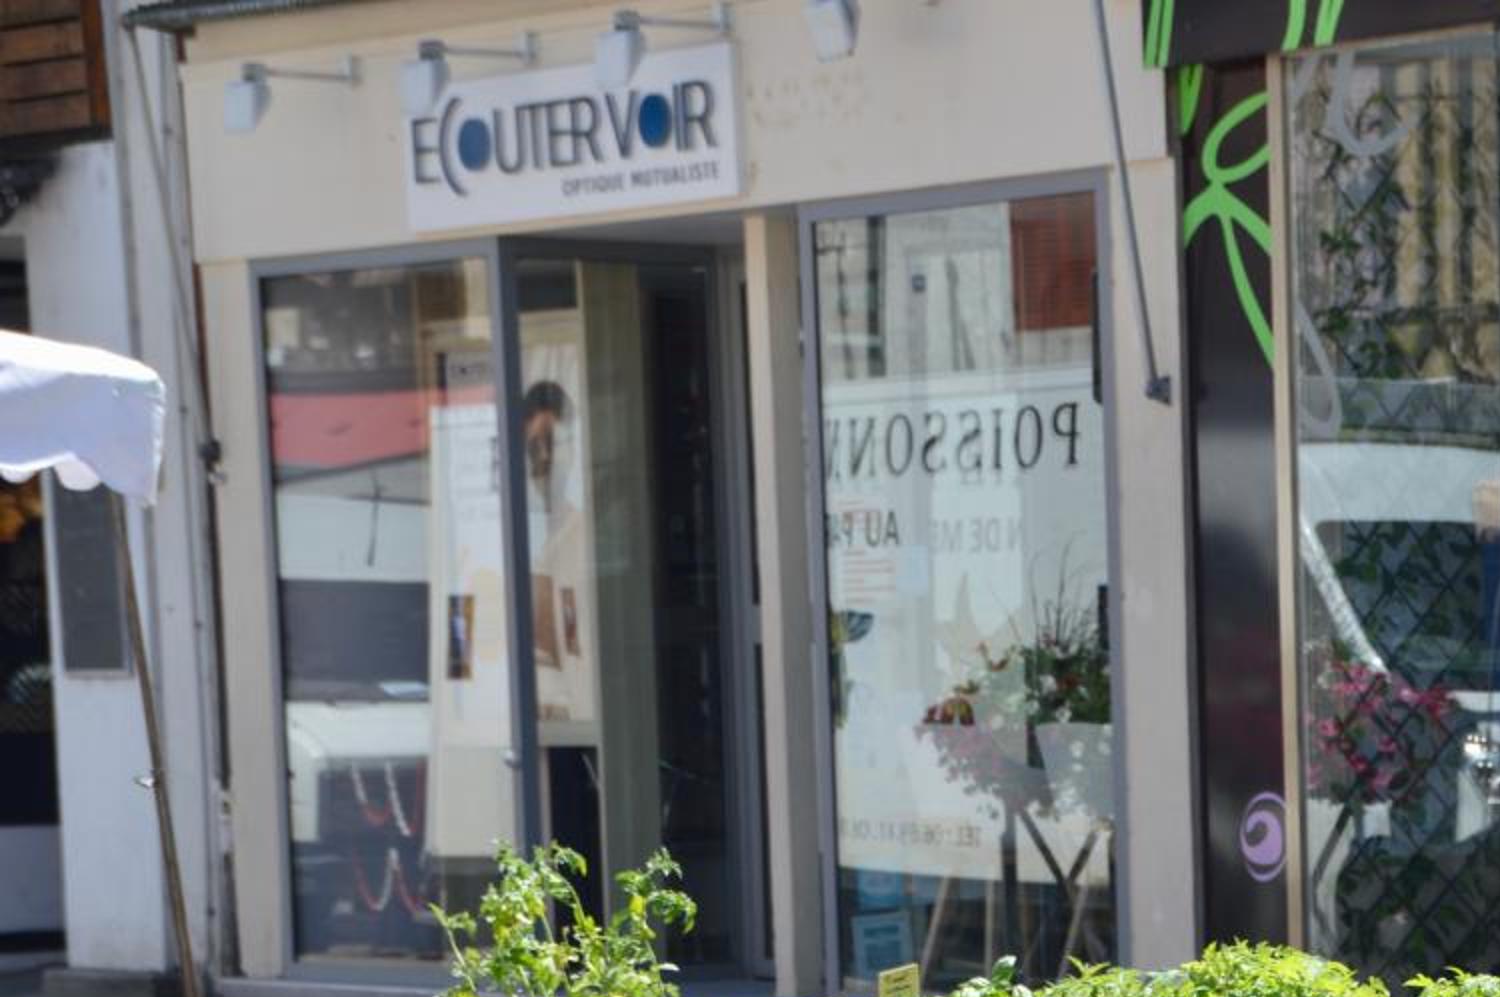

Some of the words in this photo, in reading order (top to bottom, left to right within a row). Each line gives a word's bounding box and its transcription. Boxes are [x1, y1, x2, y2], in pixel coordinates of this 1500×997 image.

[605, 80, 718, 160] VOIR
[561, 172, 625, 197] OPTIQUE
[630, 160, 720, 188] MUTUALISTE
